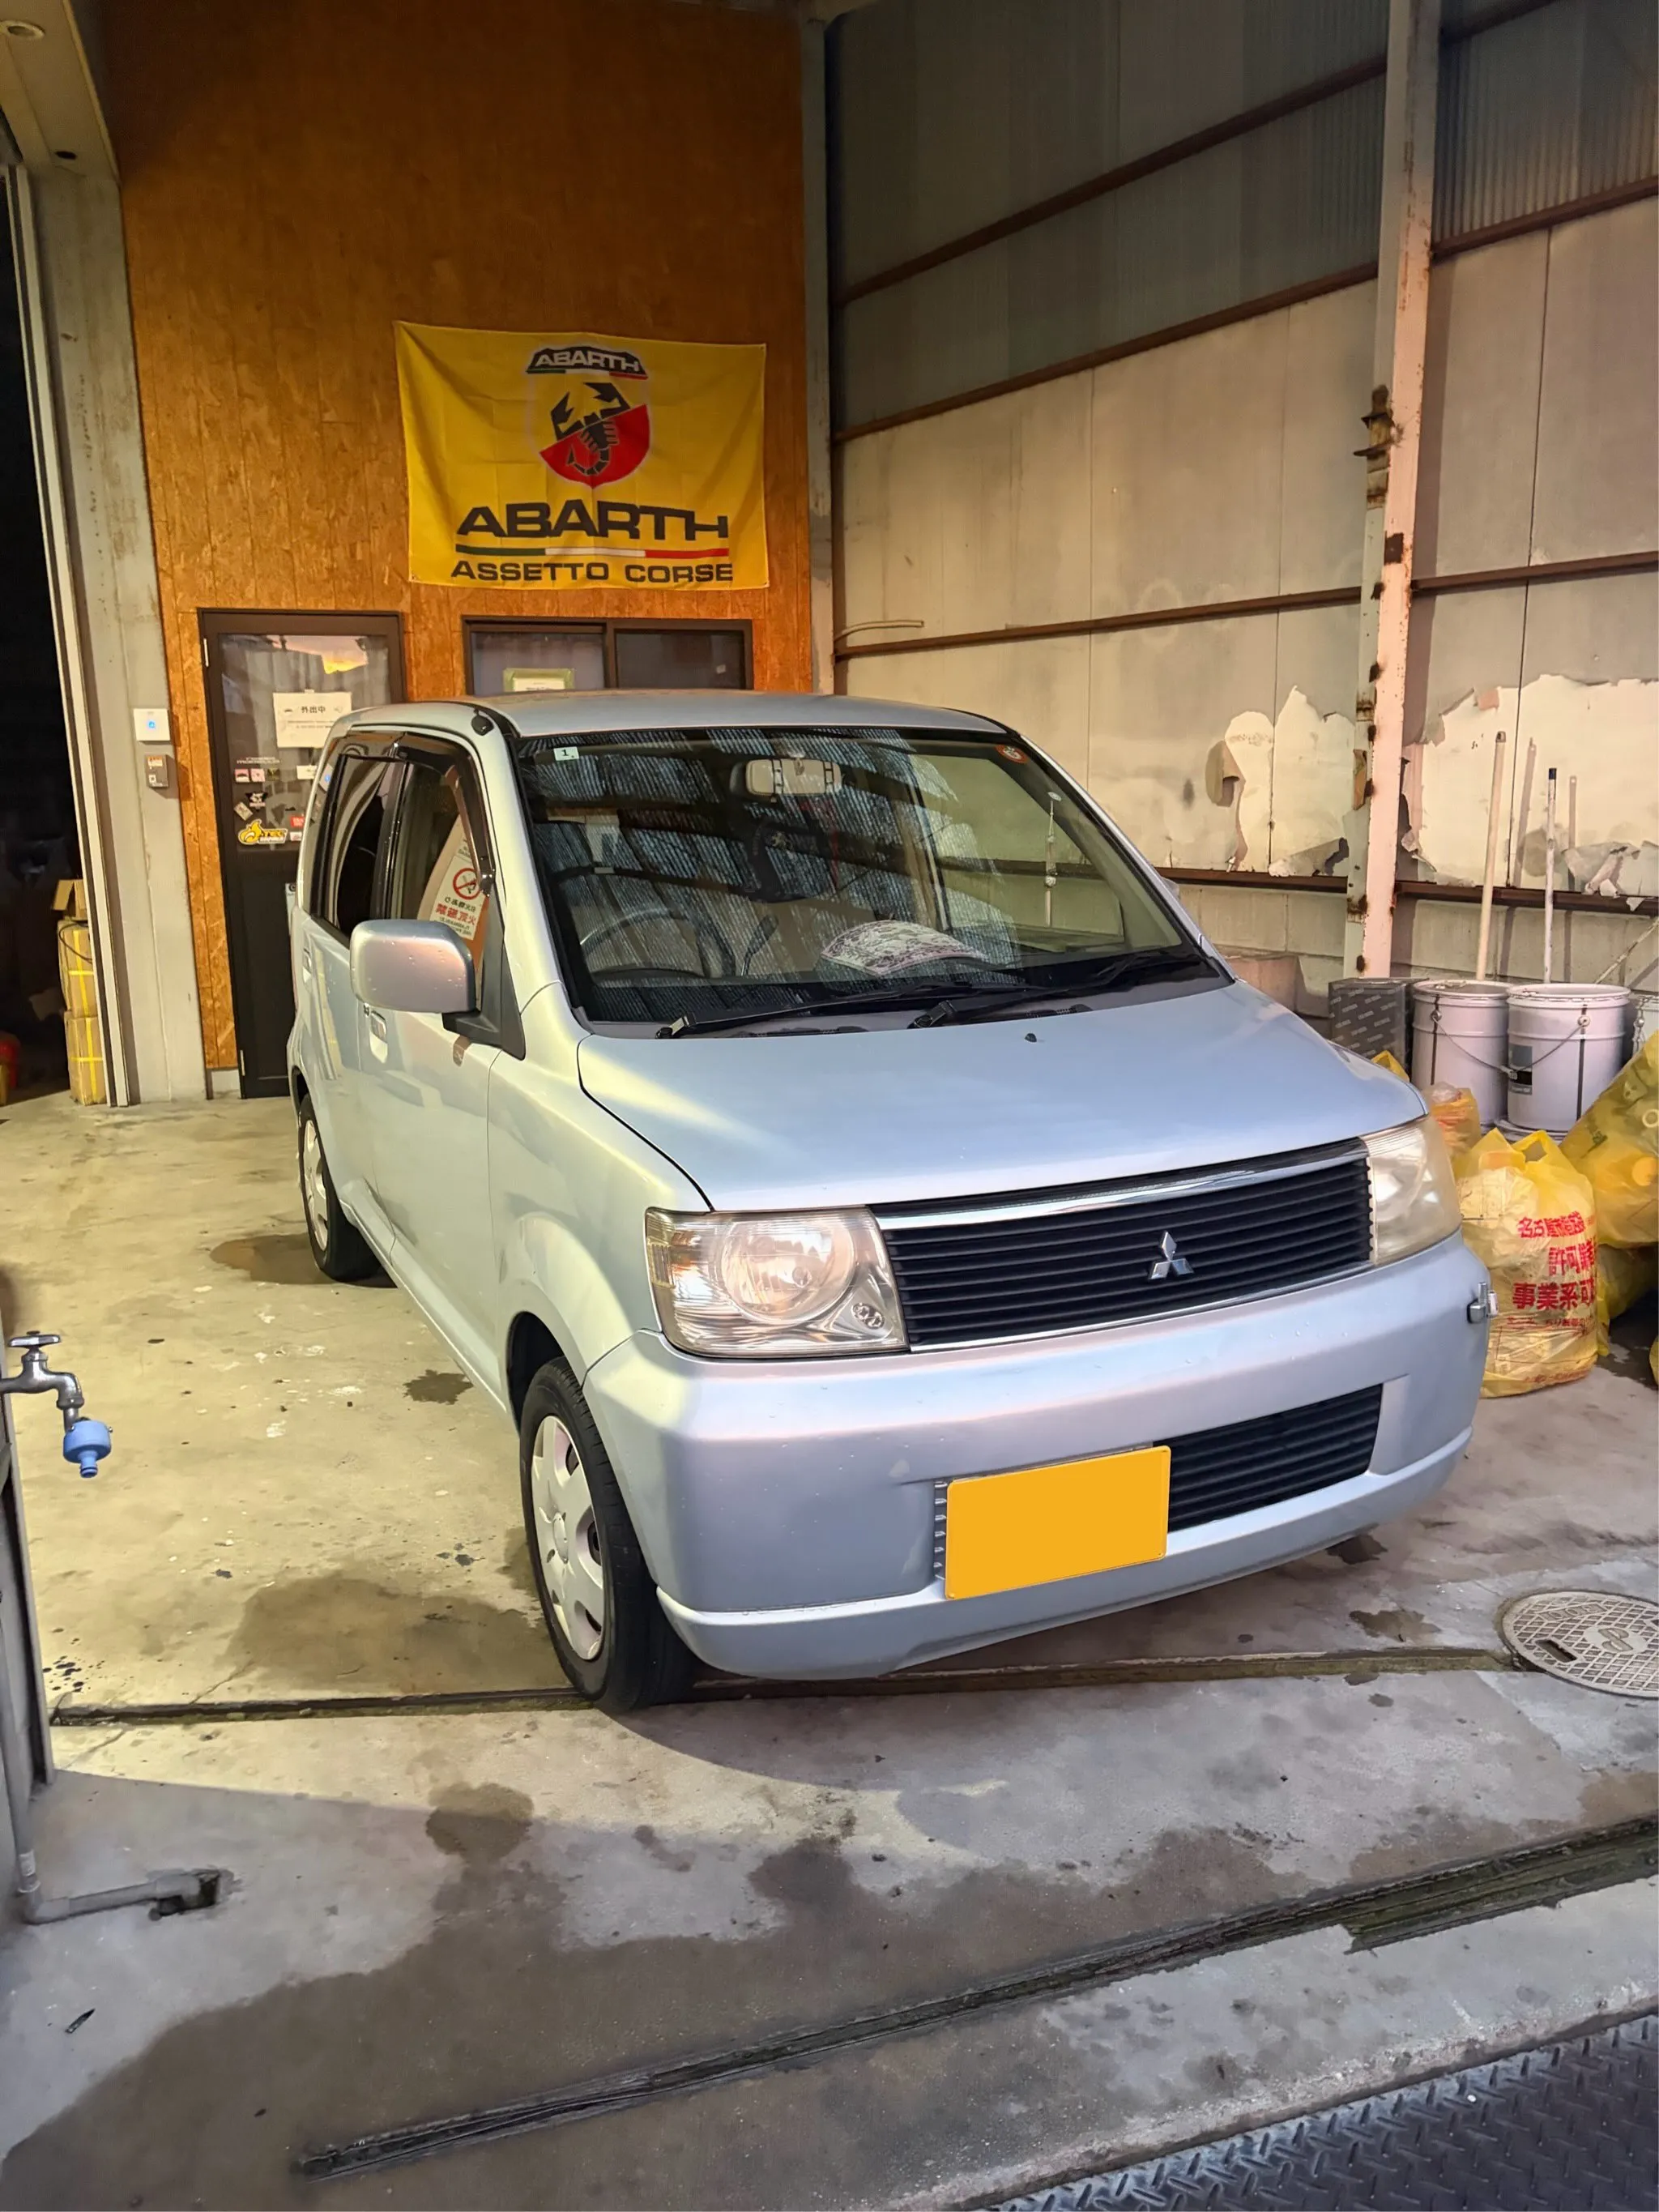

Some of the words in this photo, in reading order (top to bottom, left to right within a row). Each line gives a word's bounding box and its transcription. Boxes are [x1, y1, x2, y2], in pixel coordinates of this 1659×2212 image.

[535, 349, 639, 372] ABARTH
[456, 498, 729, 541] ABARTH
[450, 560, 609, 582] ASSETTO
[625, 564, 733, 583] CORSE
